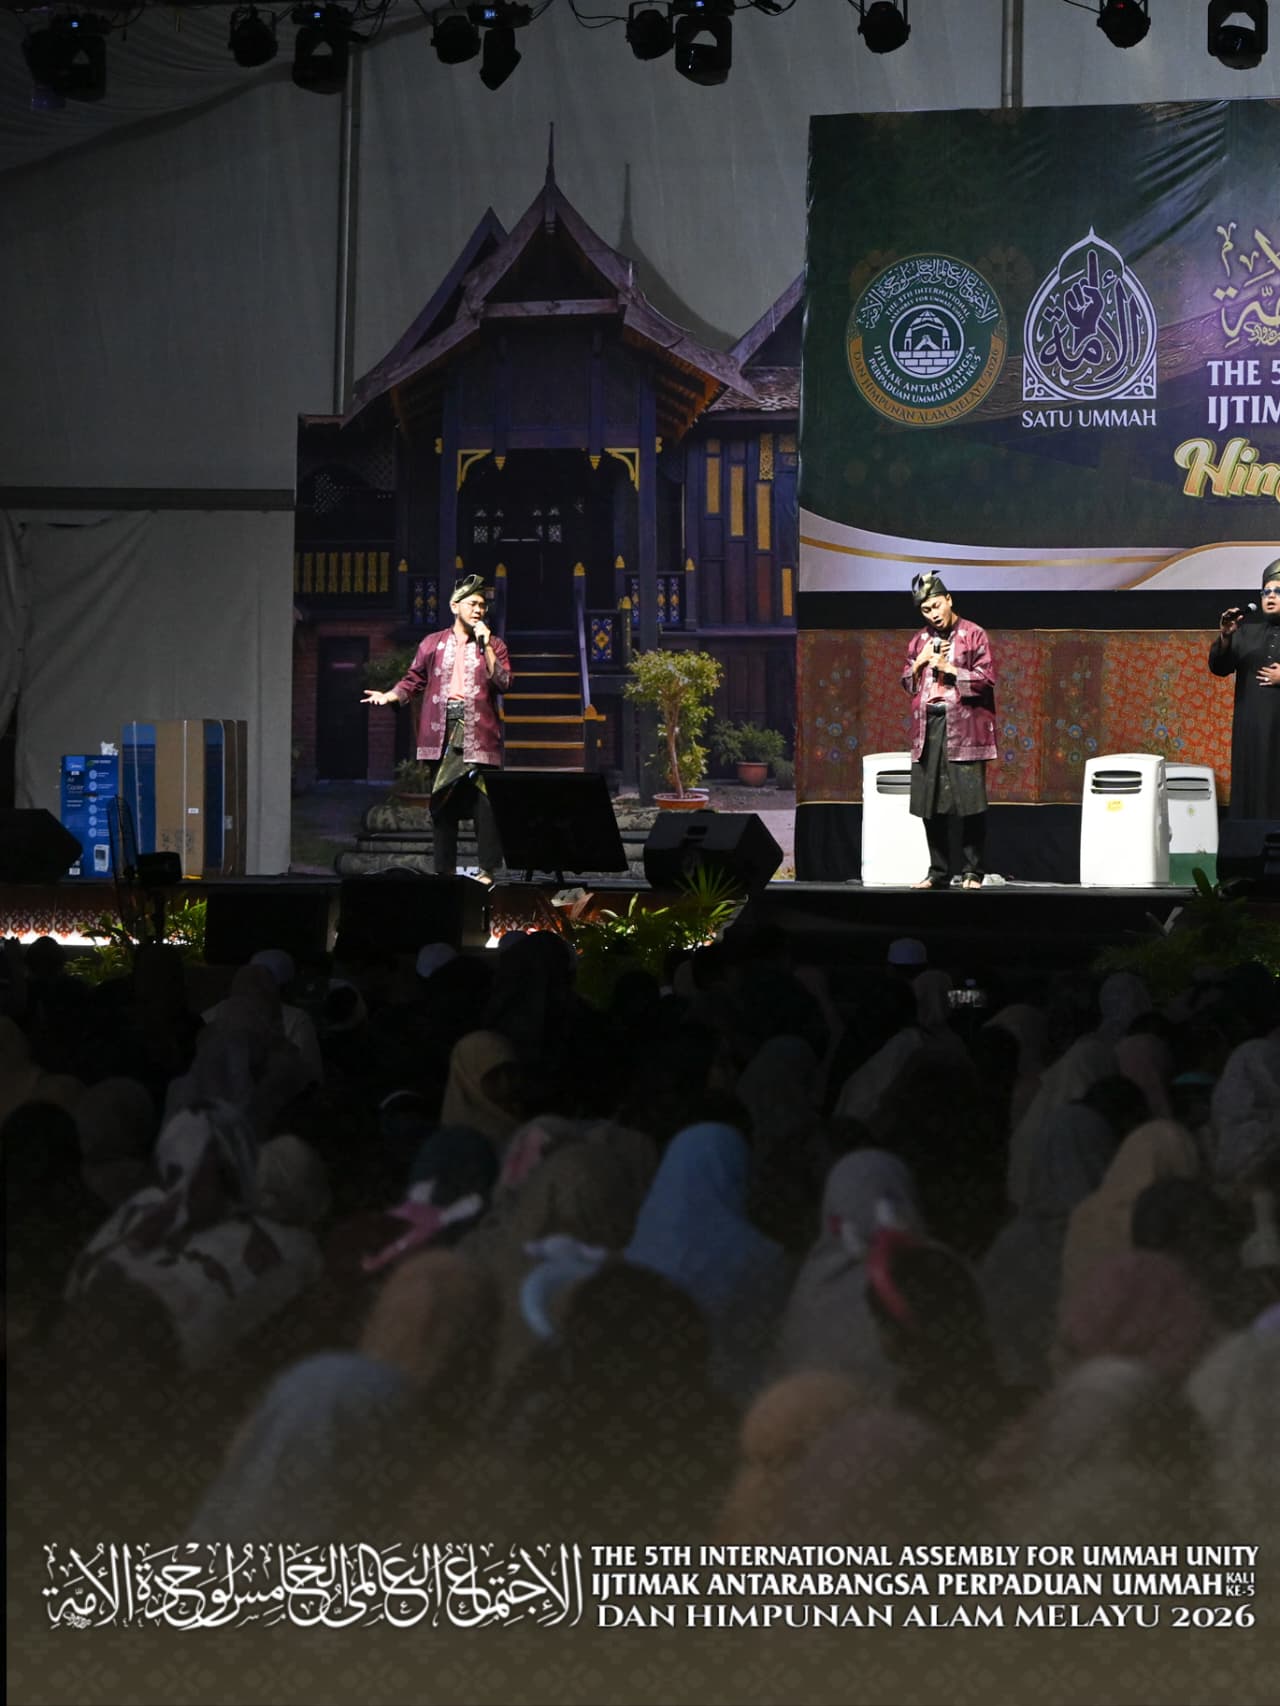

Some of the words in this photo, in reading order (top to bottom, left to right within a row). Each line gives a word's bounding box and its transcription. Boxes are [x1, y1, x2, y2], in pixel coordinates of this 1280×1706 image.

[886, 302, 898, 316] THE
[869, 357, 911, 401] PERPADUAN
[912, 390, 948, 404] UMMAH
[948, 376, 969, 396] KALI
[965, 354, 981, 377] KE-5
[873, 344, 903, 386] IJTIMAK
[903, 346, 976, 393] ANTARABANGSA
[1207, 359, 1262, 387] THE
[1021, 410, 1073, 428] SATU
[1078, 408, 1157, 427] UMMAH
